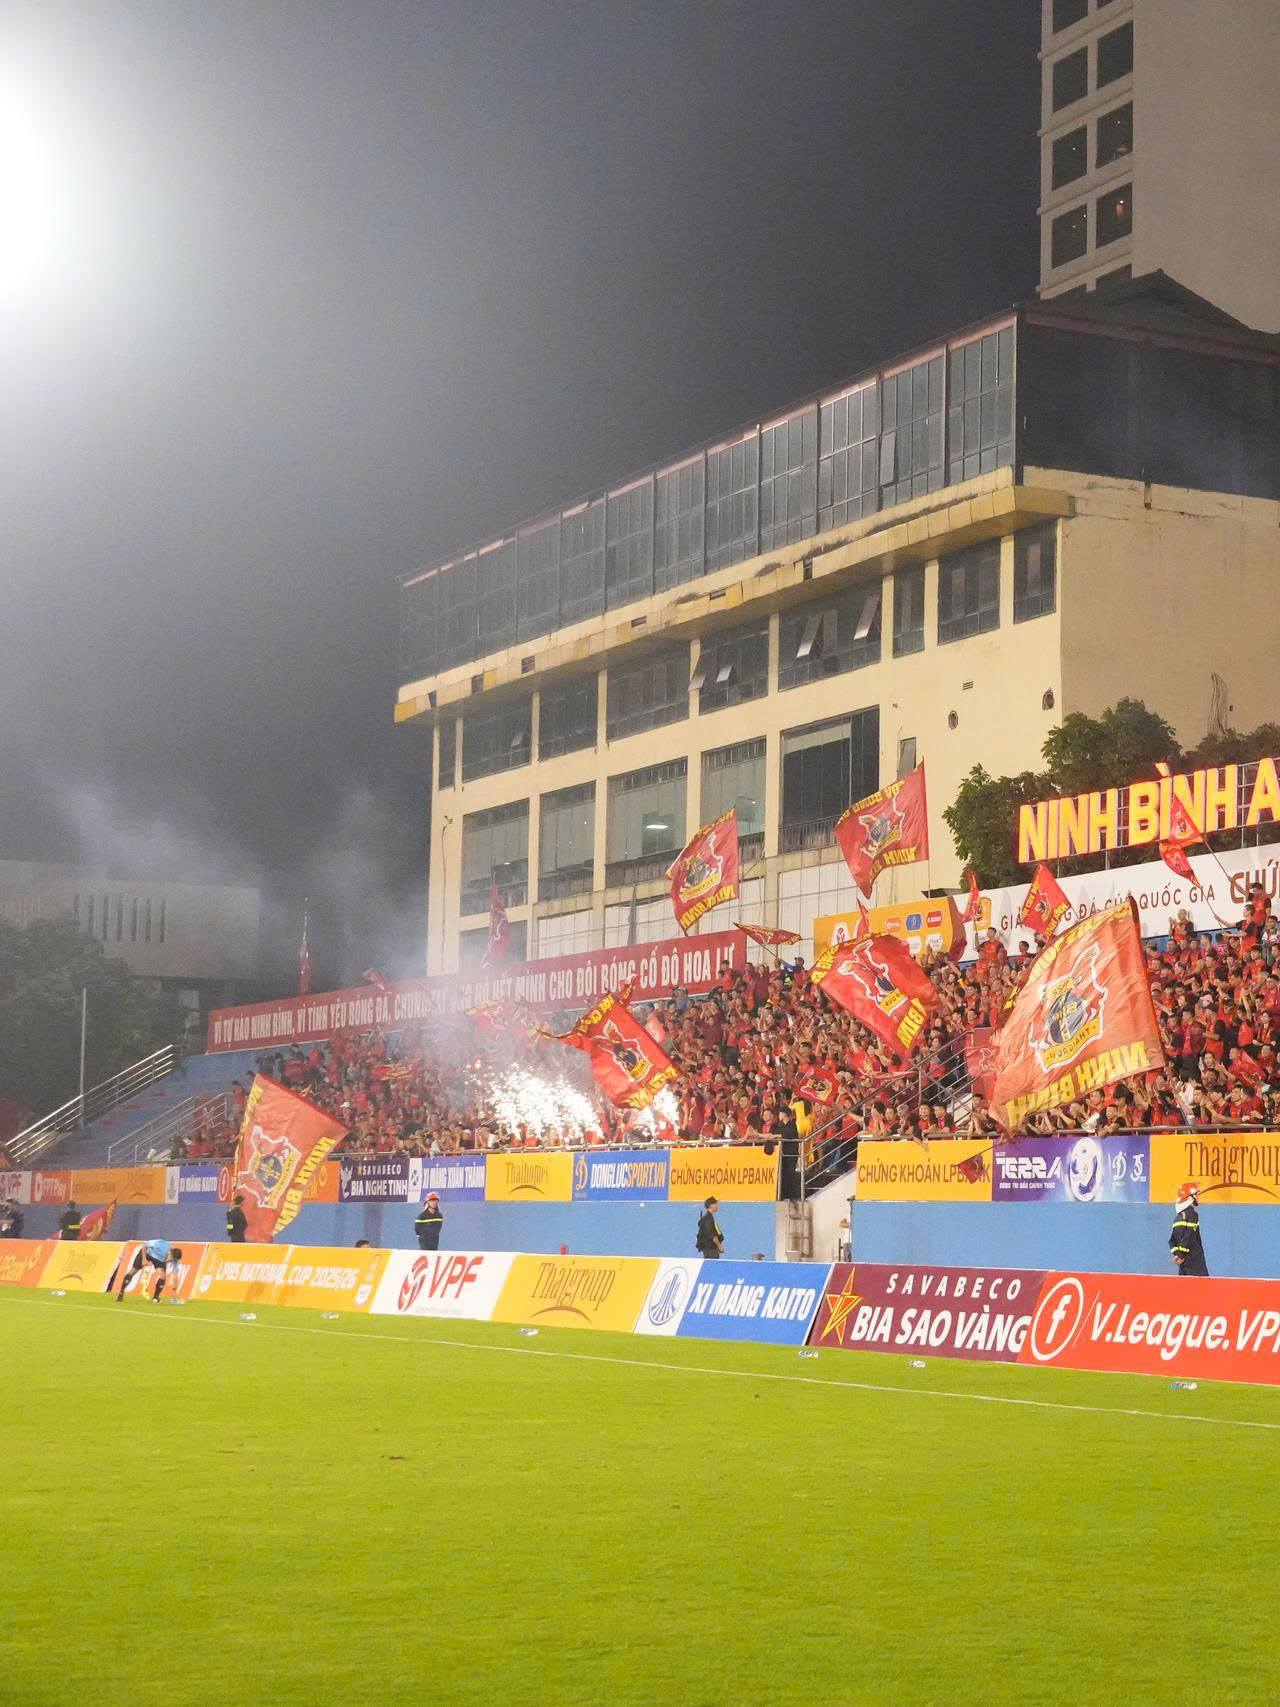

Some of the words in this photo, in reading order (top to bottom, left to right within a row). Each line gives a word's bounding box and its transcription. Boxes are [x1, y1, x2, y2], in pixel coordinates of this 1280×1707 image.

[1018, 788, 1118, 864] NINH
[1129, 763, 1239, 846] BÌNH
[1139, 883, 1181, 909] QUỐC
[1190, 884, 1217, 904] GIA
[549, 968, 573, 1000] CHO
[640, 945, 658, 990] CỐ
[661, 947, 680, 987] ĐÔ
[683, 949, 711, 984] HOA
[671, 1162, 702, 1185] CHỨNG
[703, 1161, 736, 1185] KHOÁN
[737, 1167, 775, 1185] LPBANK
[858, 1157, 898, 1184] CHỨNG
[900, 1157, 940, 1184] KHOÁN
[429, 1255, 485, 1299] VPF
[886, 1271, 1022, 1301] SAVABECO
[688, 1283, 712, 1314] XI
[711, 1278, 766, 1318] MĂNG
[764, 1285, 816, 1321] KAITO
[851, 1306, 892, 1343] BIA
[899, 1308, 951, 1346] SAO
[955, 1304, 1034, 1354] VÀNG
